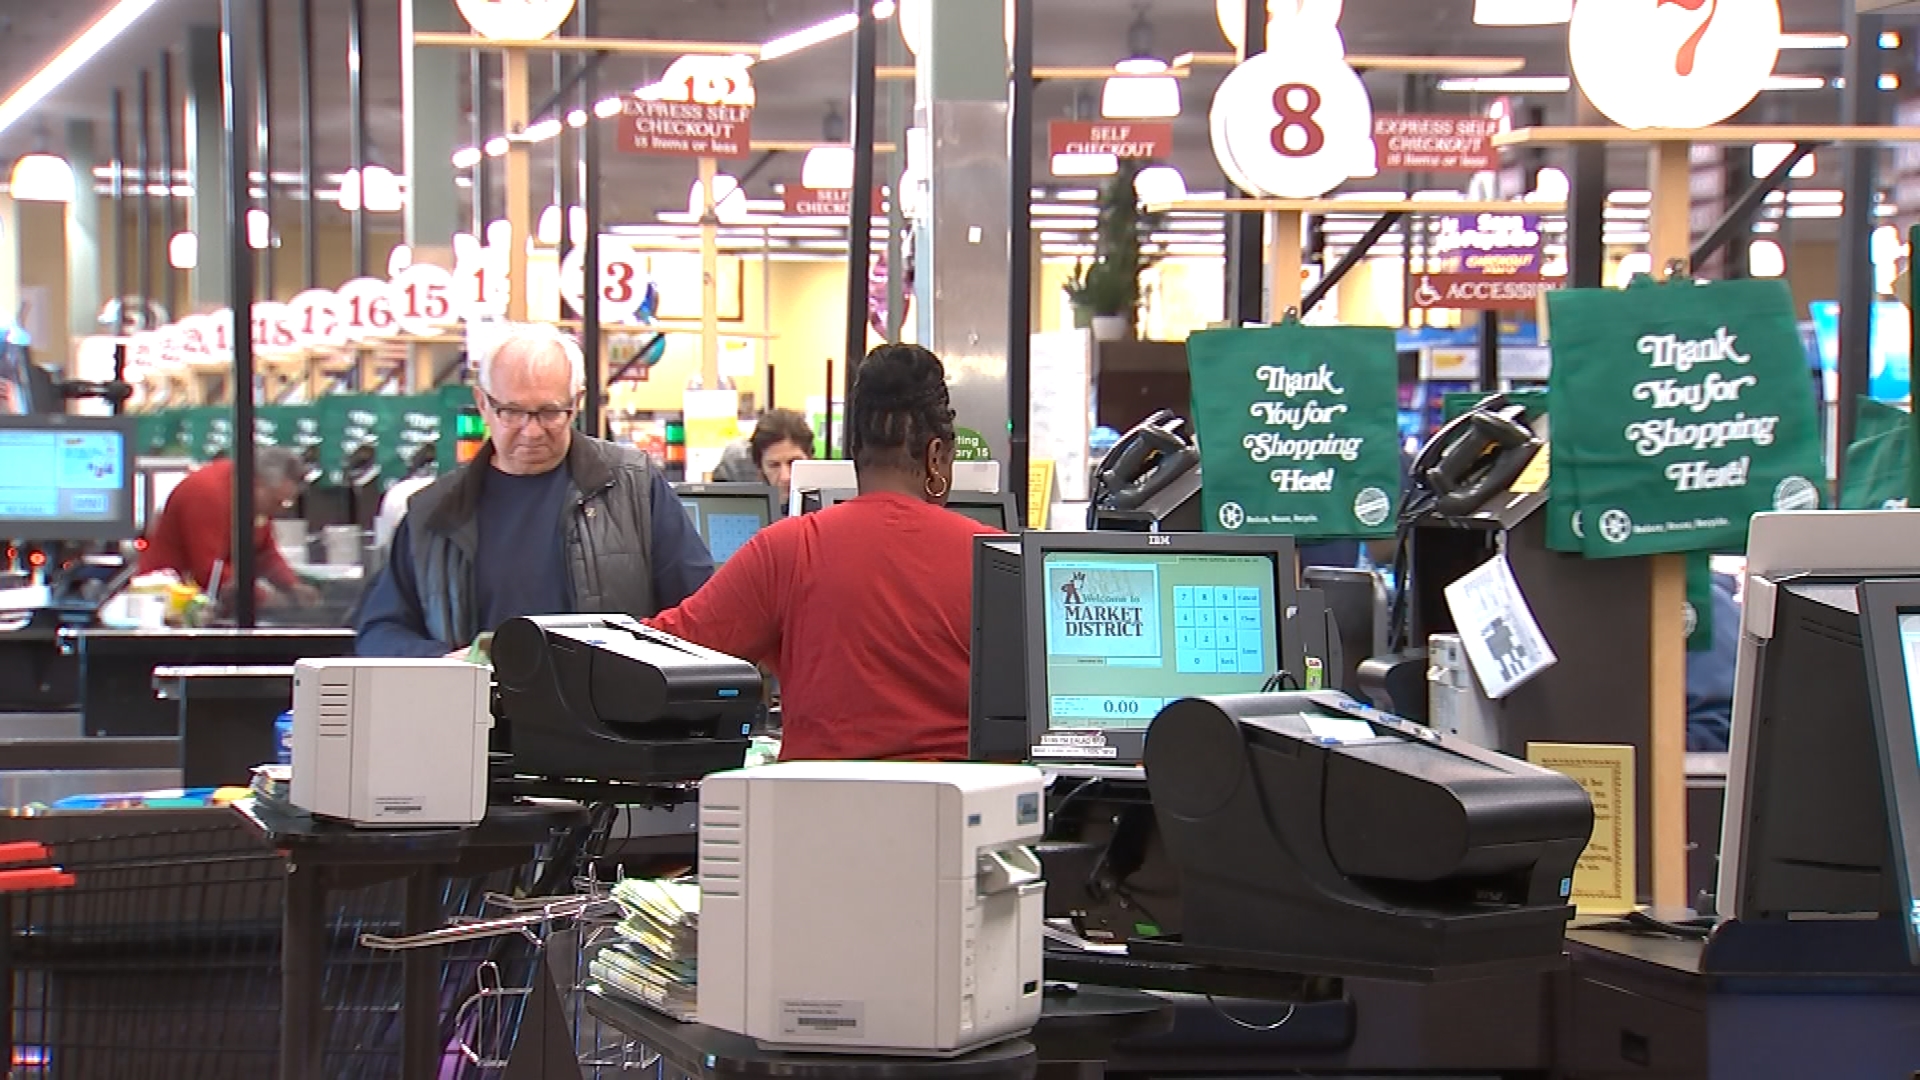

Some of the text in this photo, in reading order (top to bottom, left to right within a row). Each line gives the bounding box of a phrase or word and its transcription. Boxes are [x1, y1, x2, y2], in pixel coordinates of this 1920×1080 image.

[1657, 0, 1718, 76] 7
[621, 101, 750, 123] EXPRESS SELF
[1270, 82, 1325, 158] 8
[635, 117, 735, 138] CHECKOUT
[1090, 126, 1131, 140] SELF
[1375, 118, 1454, 135] EXPRESS
[1065, 142, 1156, 158] CHECKOUT
[1388, 136, 1482, 153] CHECKOUT
[796, 201, 850, 215] CHECK
[404, 283, 449, 318] 15
[301, 306, 338, 336] 17
[350, 296, 396, 328] 16
[257, 318, 297, 346] 18
[1637, 326, 1750, 372] Thank
[1256, 363, 1344, 397] Thank
[1625, 412, 1780, 456] Shopping
[976, 447, 988, 457] 15
[1243, 432, 1363, 462] Shopping
[1270, 467, 1335, 492] Here!
[1665, 456, 1750, 491] Here!
[1148, 535, 1170, 545] IBM
[1083, 594, 1141, 603] Welcome to
[1064, 605, 1143, 621] MARKET
[1065, 621, 1143, 636] DISTRICT
[1103, 699, 1138, 714] 0.00
